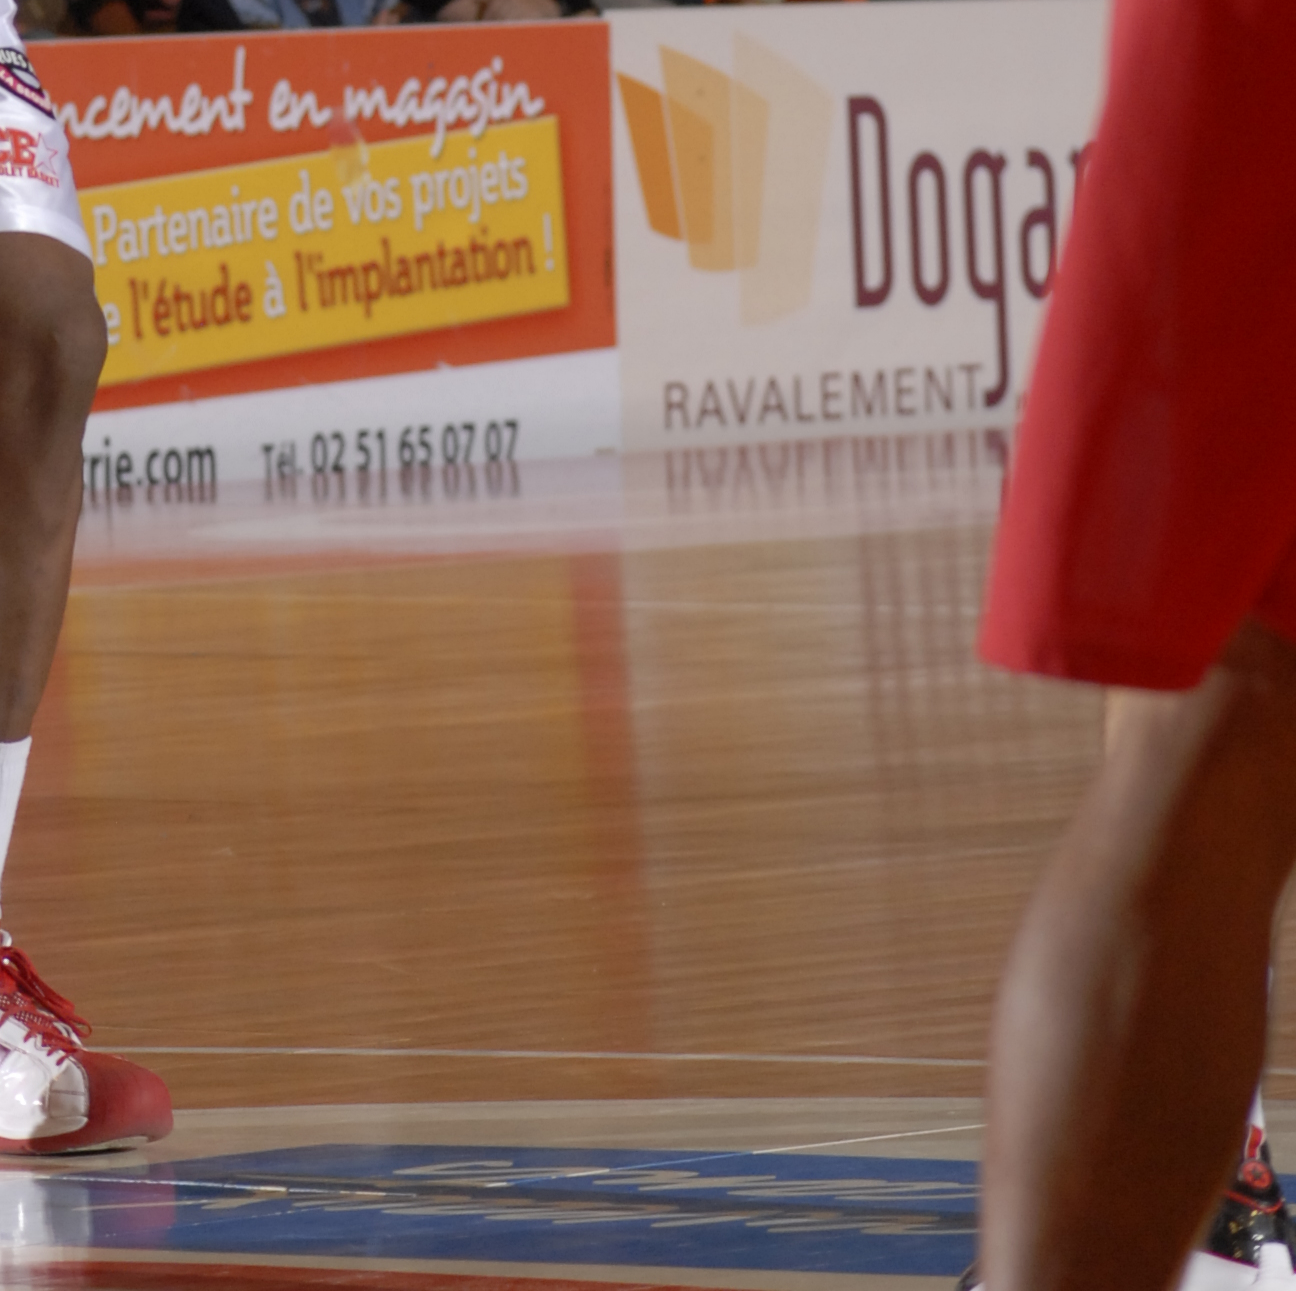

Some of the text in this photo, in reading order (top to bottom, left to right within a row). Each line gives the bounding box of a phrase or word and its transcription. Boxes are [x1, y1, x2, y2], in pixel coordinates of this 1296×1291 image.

[45, 45, 545, 159] ncement en magasin
[92, 147, 529, 265] Partenaire de vos projets
[103, 302, 122, 347] e
[128, 263, 253, 340] l'étude
[262, 260, 287, 319] à
[295, 225, 537, 319] l'implantation
[664, 363, 983, 433] RAVALEMENT
[82, 435, 217, 489] rie.com
[311, 430, 346, 473] 02
[356, 428, 388, 470] 51
[398, 425, 433, 466] 65
[442, 422, 477, 463] 07
[484, 419, 521, 462] 07
